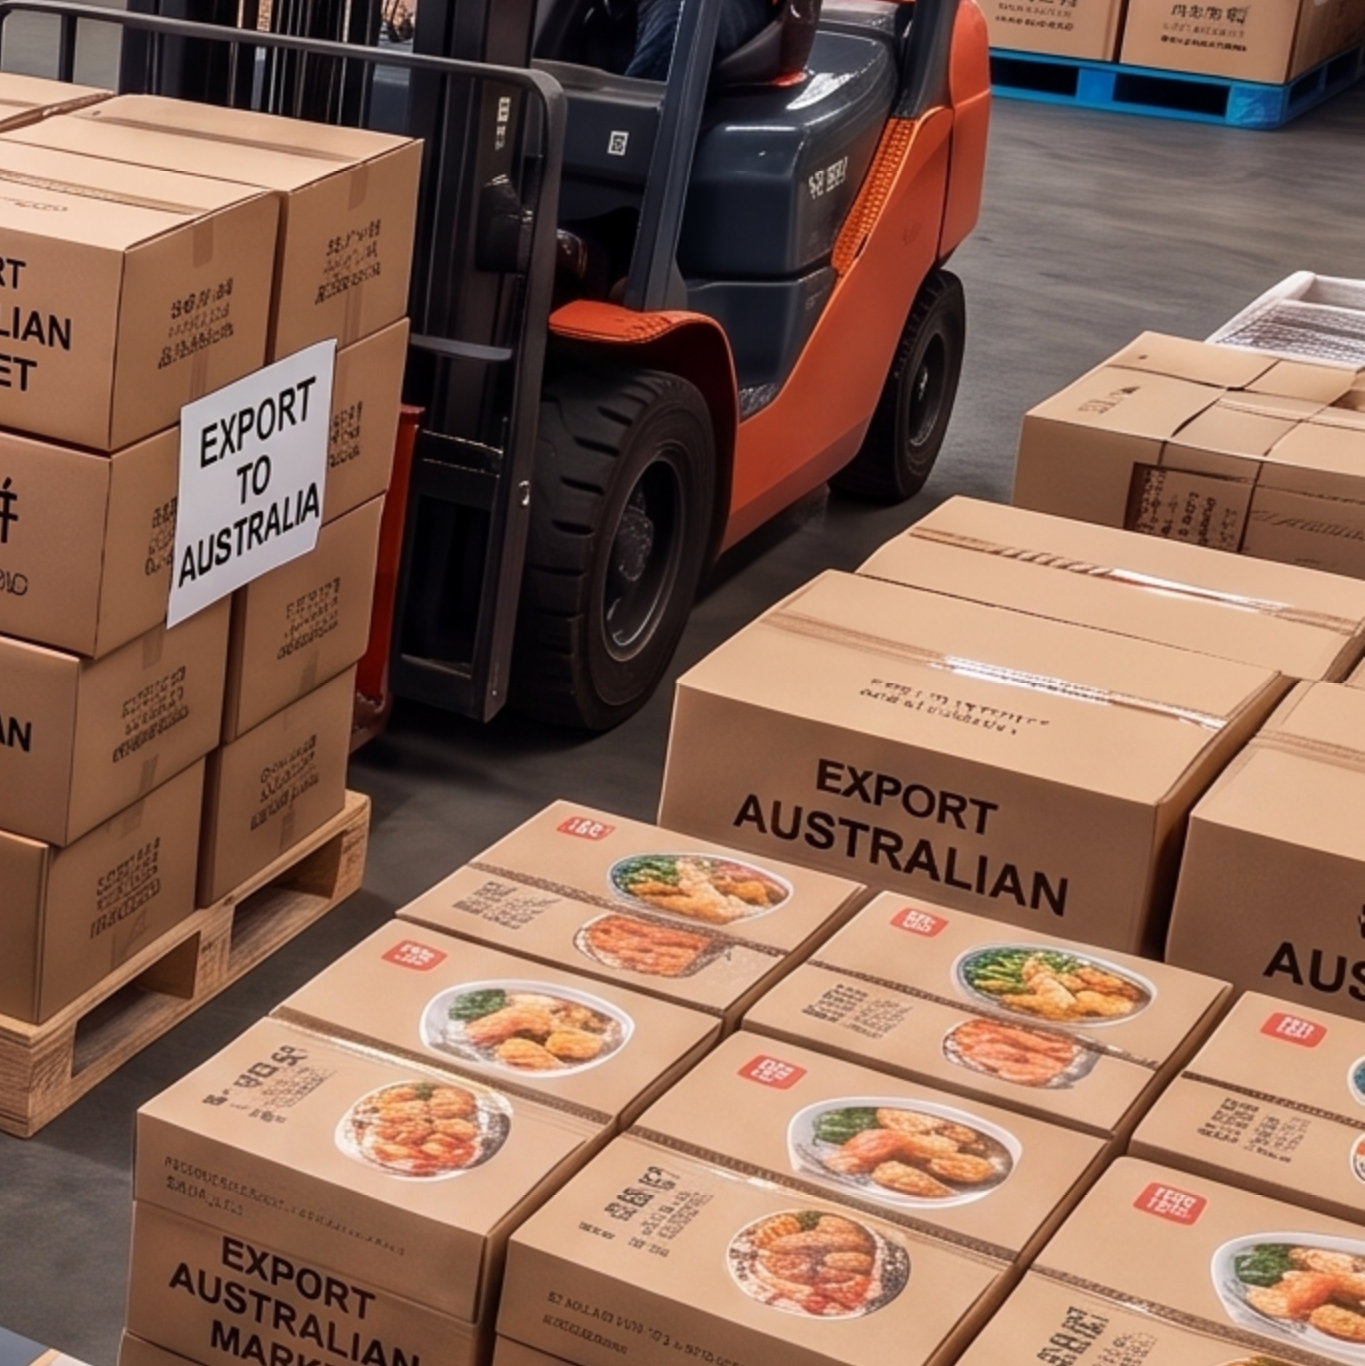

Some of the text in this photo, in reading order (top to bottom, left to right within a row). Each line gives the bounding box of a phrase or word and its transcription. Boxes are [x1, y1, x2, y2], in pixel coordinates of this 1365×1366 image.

[201, 376, 316, 468] EXPORT
[237, 455, 271, 504] TO
[178, 483, 319, 587] AUSTRALIA
[817, 759, 998, 834] EXPORT
[733, 795, 1068, 917] AUSTRALIAN
[223, 1236, 375, 1318] EXPORT
